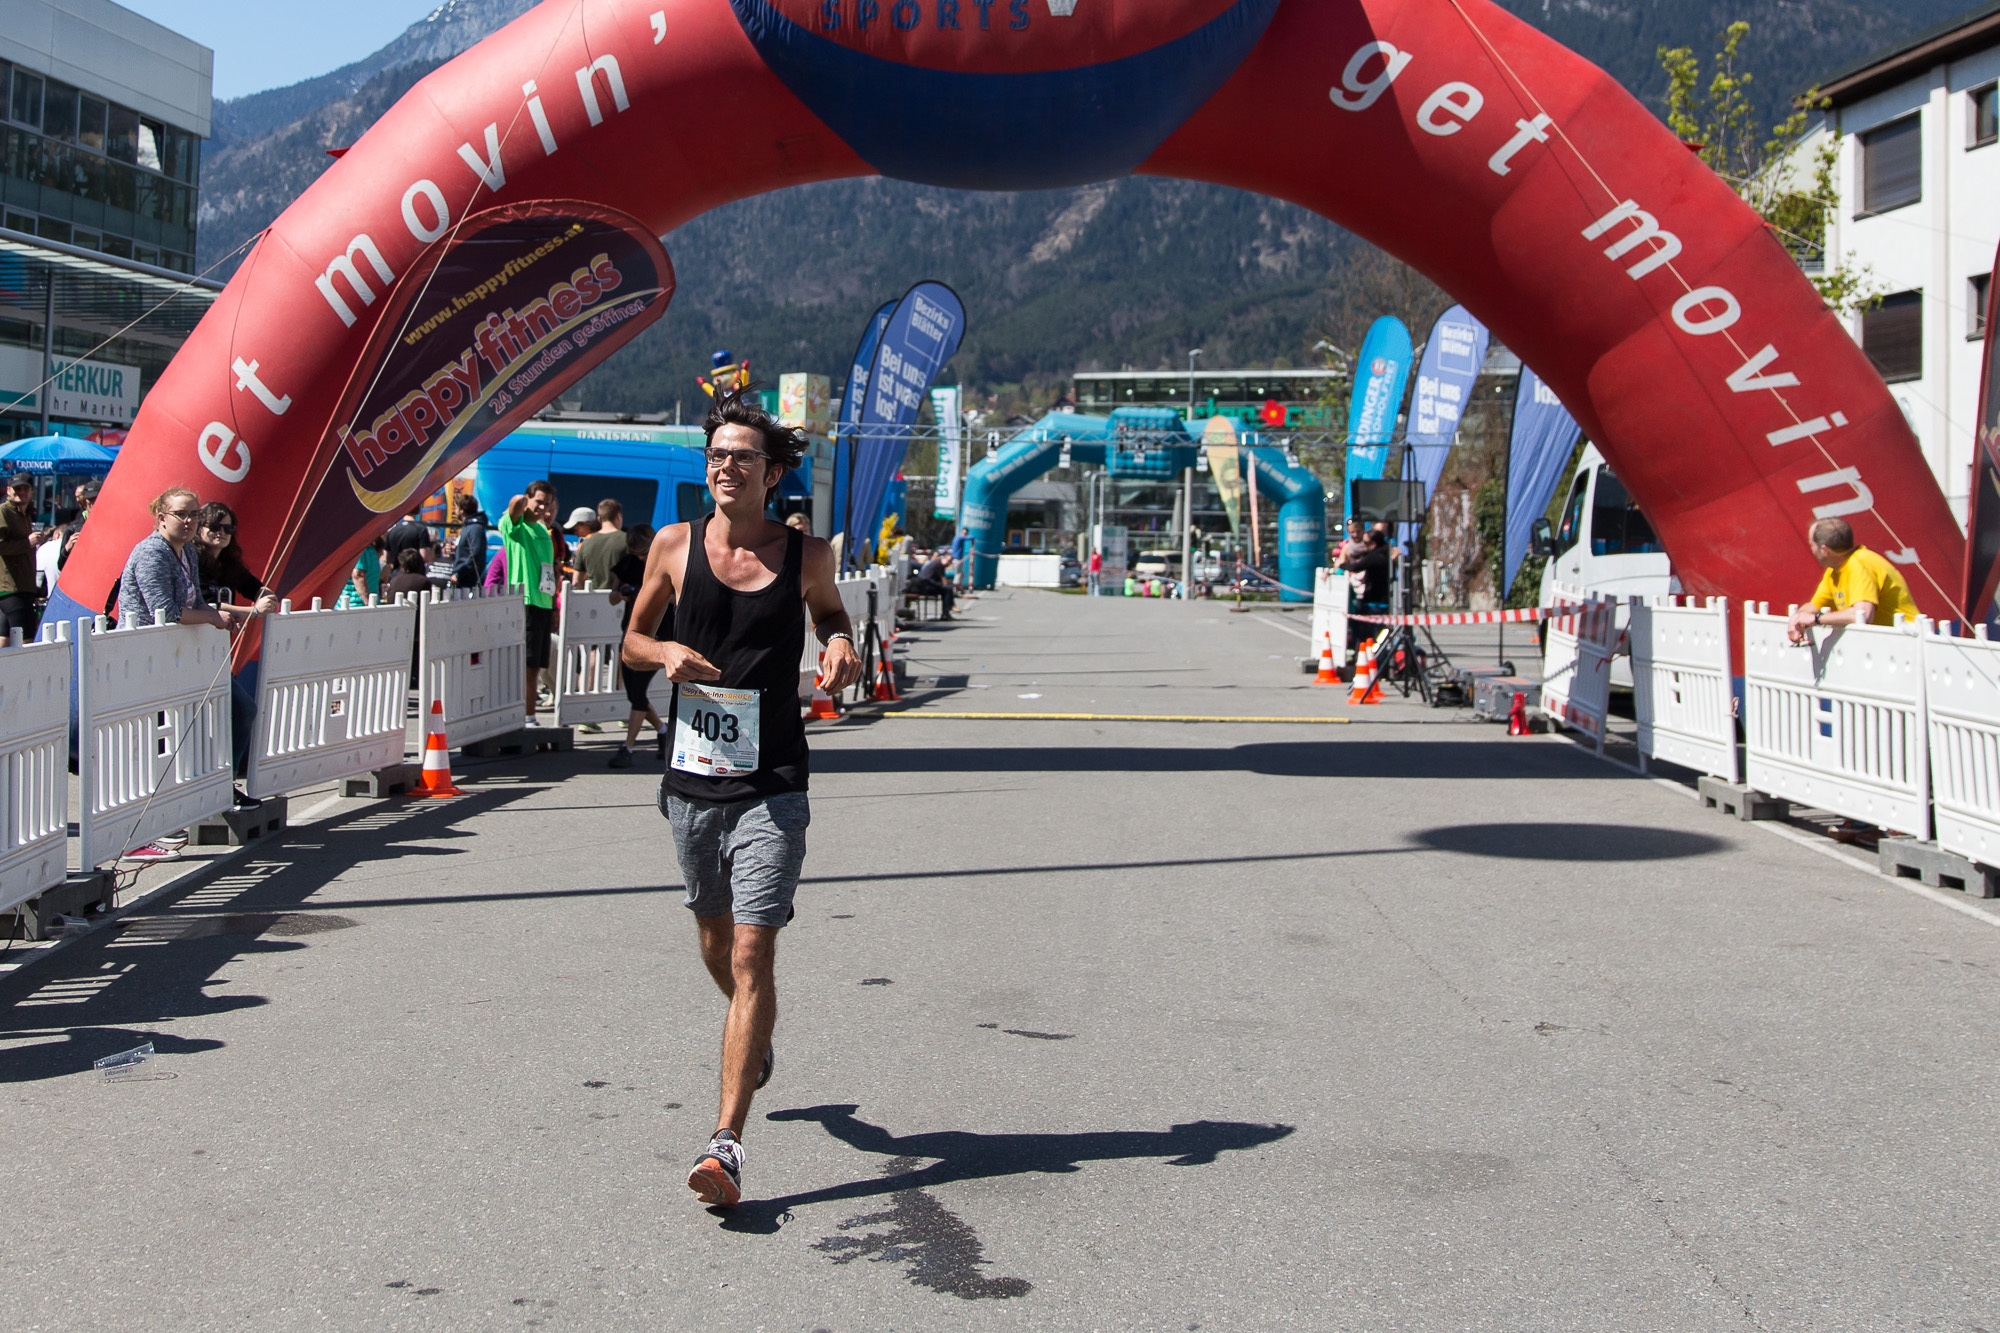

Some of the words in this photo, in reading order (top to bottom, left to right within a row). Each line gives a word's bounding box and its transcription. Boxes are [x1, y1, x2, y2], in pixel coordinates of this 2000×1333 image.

[1329, 40, 1553, 177] get
[403, 222, 584, 346] www.happyfitness.at
[911, 312, 943, 342] Blätter
[914, 297, 950, 330] Bezirks
[488, 393, 512, 415] 24
[508, 338, 573, 396] Stunden
[572, 298, 646, 347] geöffnet
[881, 344, 902, 375] Bei
[902, 362, 926, 389] uns
[50, 358, 123, 398] MERKUR
[878, 367, 895, 396] ist
[895, 381, 920, 410] was
[1418, 375, 1439, 397] Bei
[1439, 382, 1461, 403] uns
[80, 400, 123, 418] Markt
[875, 391, 898, 423] los!
[1352, 376, 1384, 458] ERDINGER
[1435, 400, 1459, 422] was
[691, 708, 740, 743] 403
